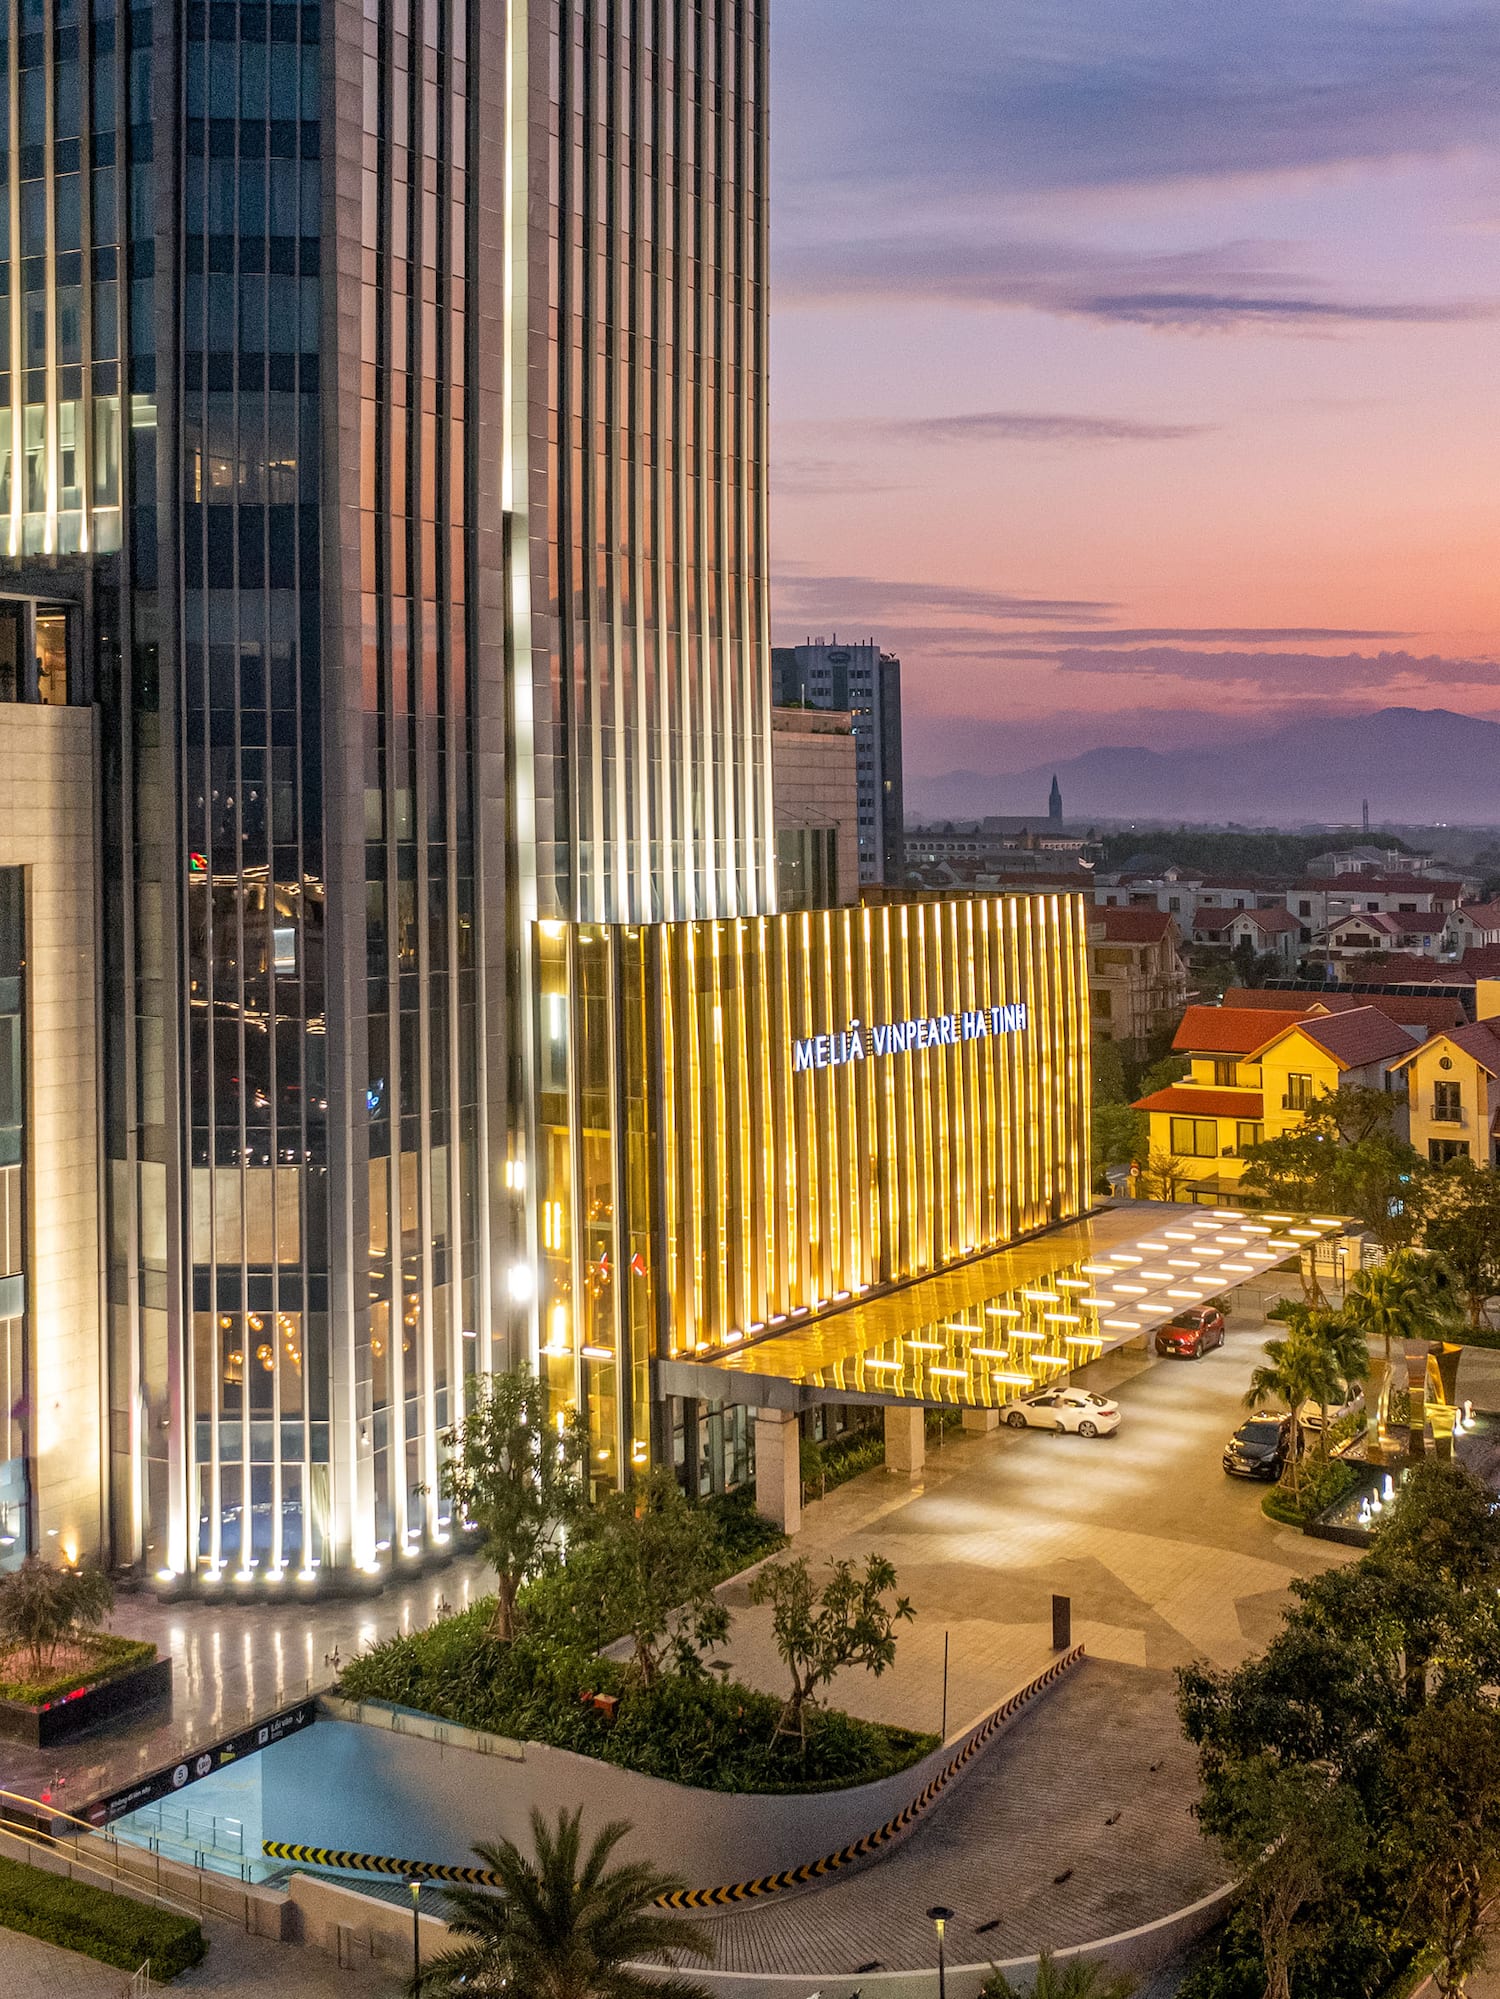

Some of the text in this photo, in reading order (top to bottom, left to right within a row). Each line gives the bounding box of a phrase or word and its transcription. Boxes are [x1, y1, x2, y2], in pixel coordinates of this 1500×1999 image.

[872, 1014, 959, 1057] VINPEARL
[963, 1010, 987, 1041] HA
[991, 1003, 1027, 1036] TINH
